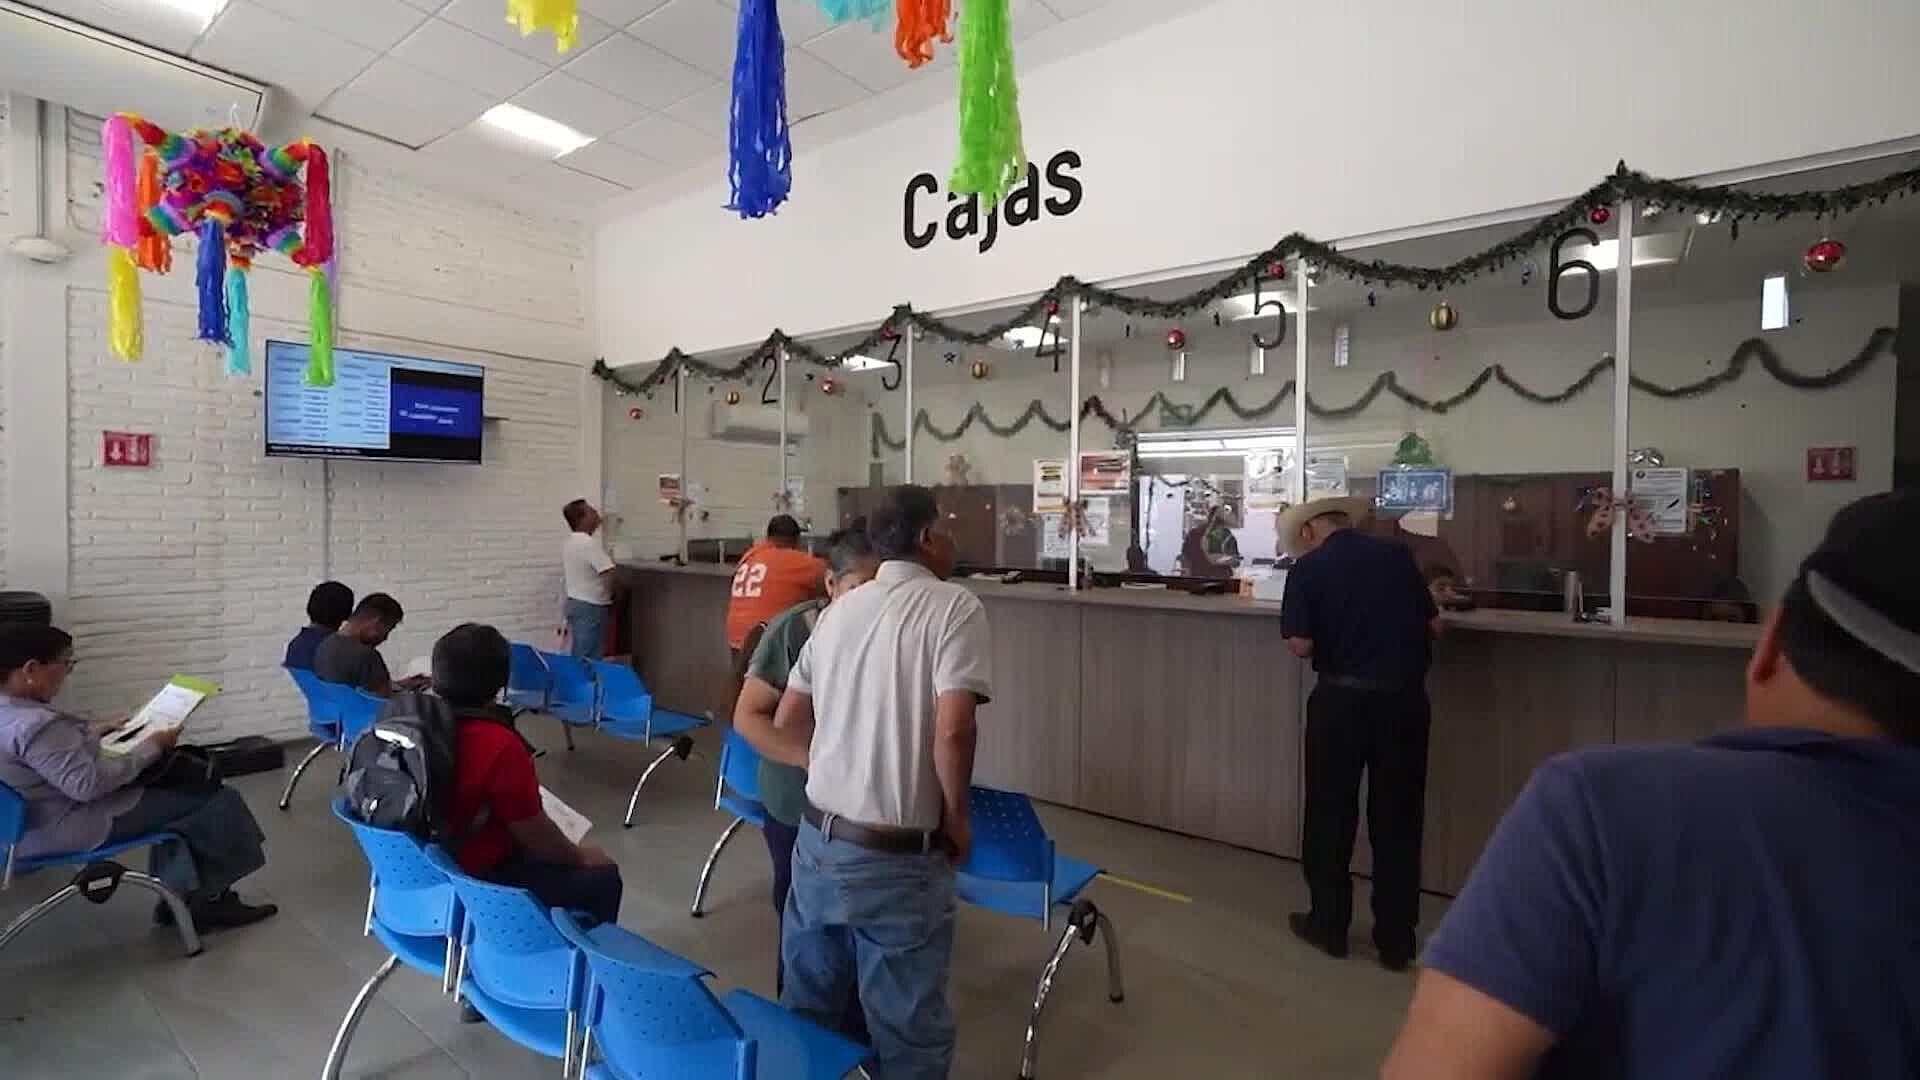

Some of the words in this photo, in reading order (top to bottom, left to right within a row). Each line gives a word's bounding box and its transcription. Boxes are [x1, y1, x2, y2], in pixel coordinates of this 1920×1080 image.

[904, 149, 1083, 254] Cajas
[1547, 228, 1599, 320] 6
[1034, 306, 1066, 372] 4
[1252, 272, 1286, 350] 5
[671, 367, 679, 413] 1
[761, 354, 779, 404] 2
[881, 334, 902, 391] 3
[731, 562, 768, 598] 22
